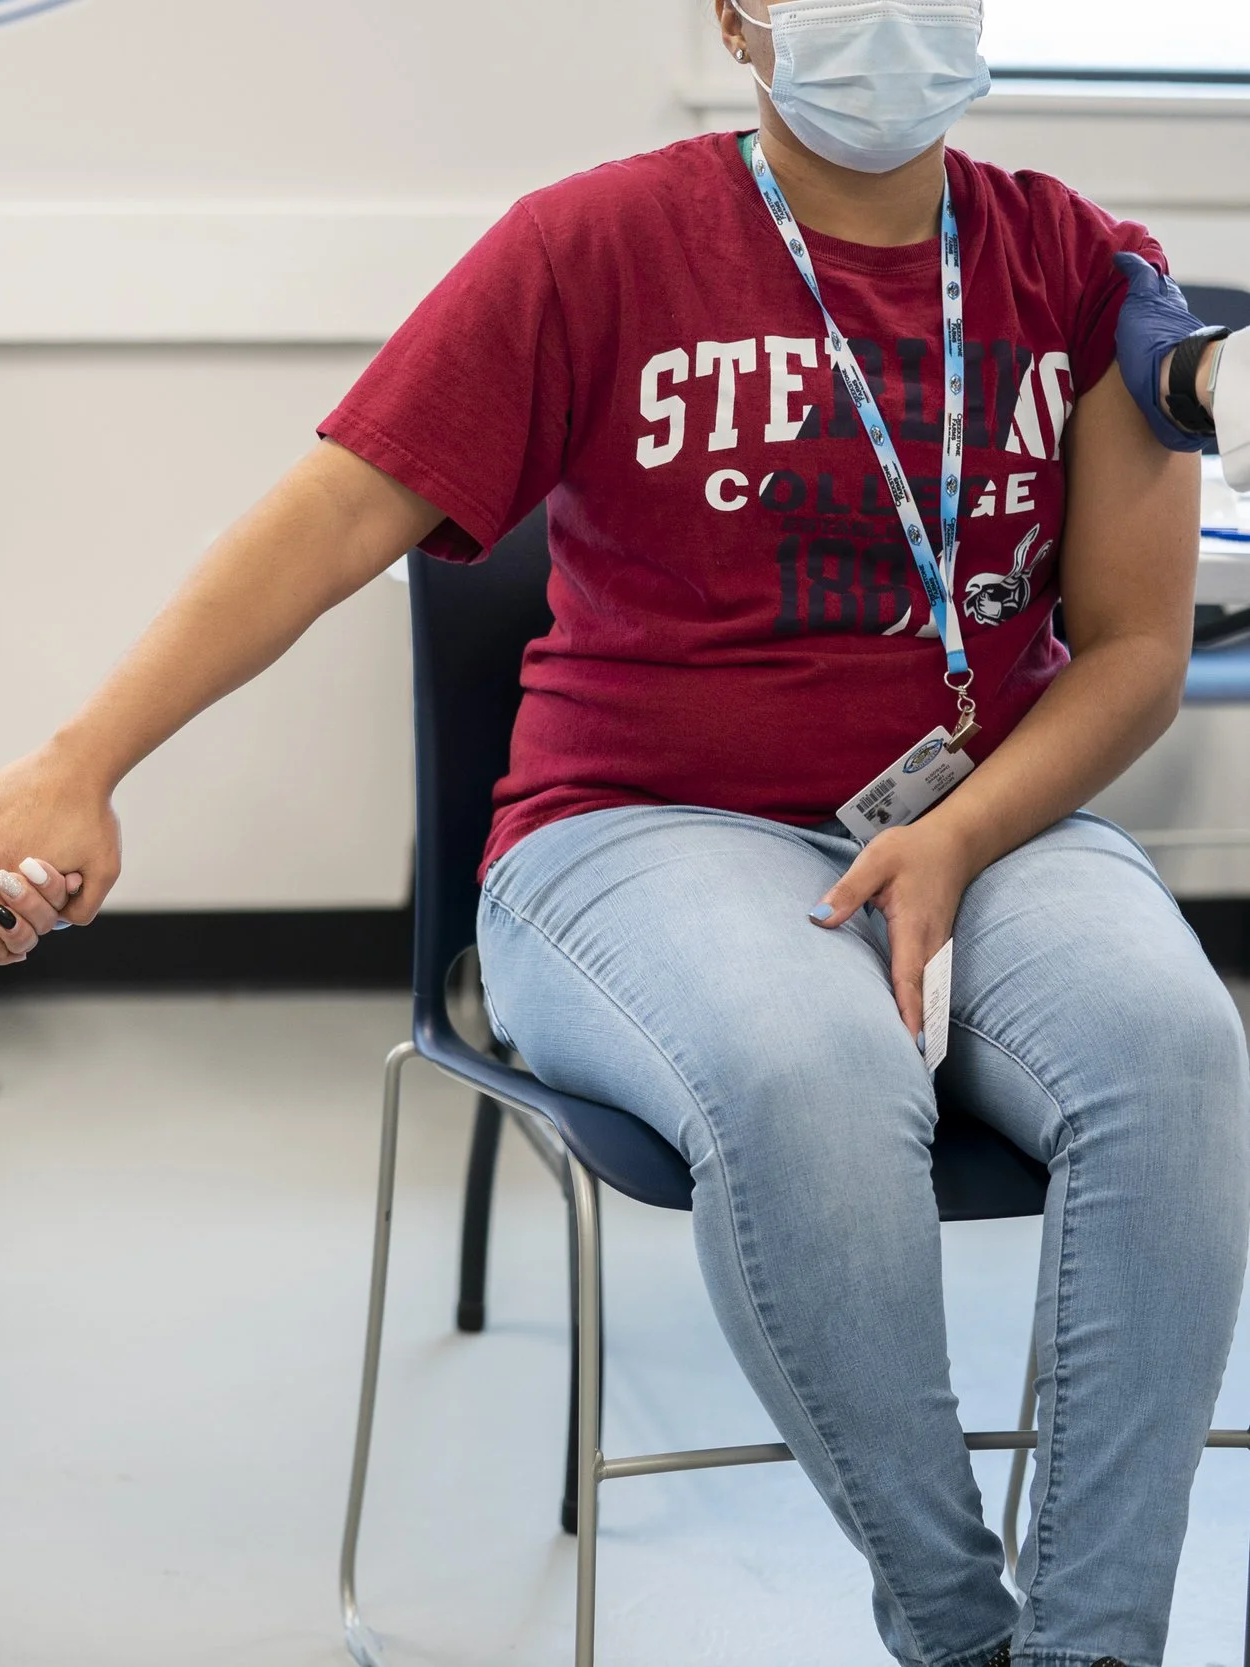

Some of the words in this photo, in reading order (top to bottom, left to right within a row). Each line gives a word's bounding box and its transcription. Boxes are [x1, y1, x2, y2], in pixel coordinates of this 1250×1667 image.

[773, 200, 786, 220] FARMS
[841, 368, 862, 408] CREEKSTONE
[852, 379, 865, 401] FARMS
[955, 413, 963, 457] CREEKSTONE
[705, 467, 1037, 518] COLLEGE
[883, 464, 902, 507] CREEKSTONE
[893, 477, 905, 503] FARMS
